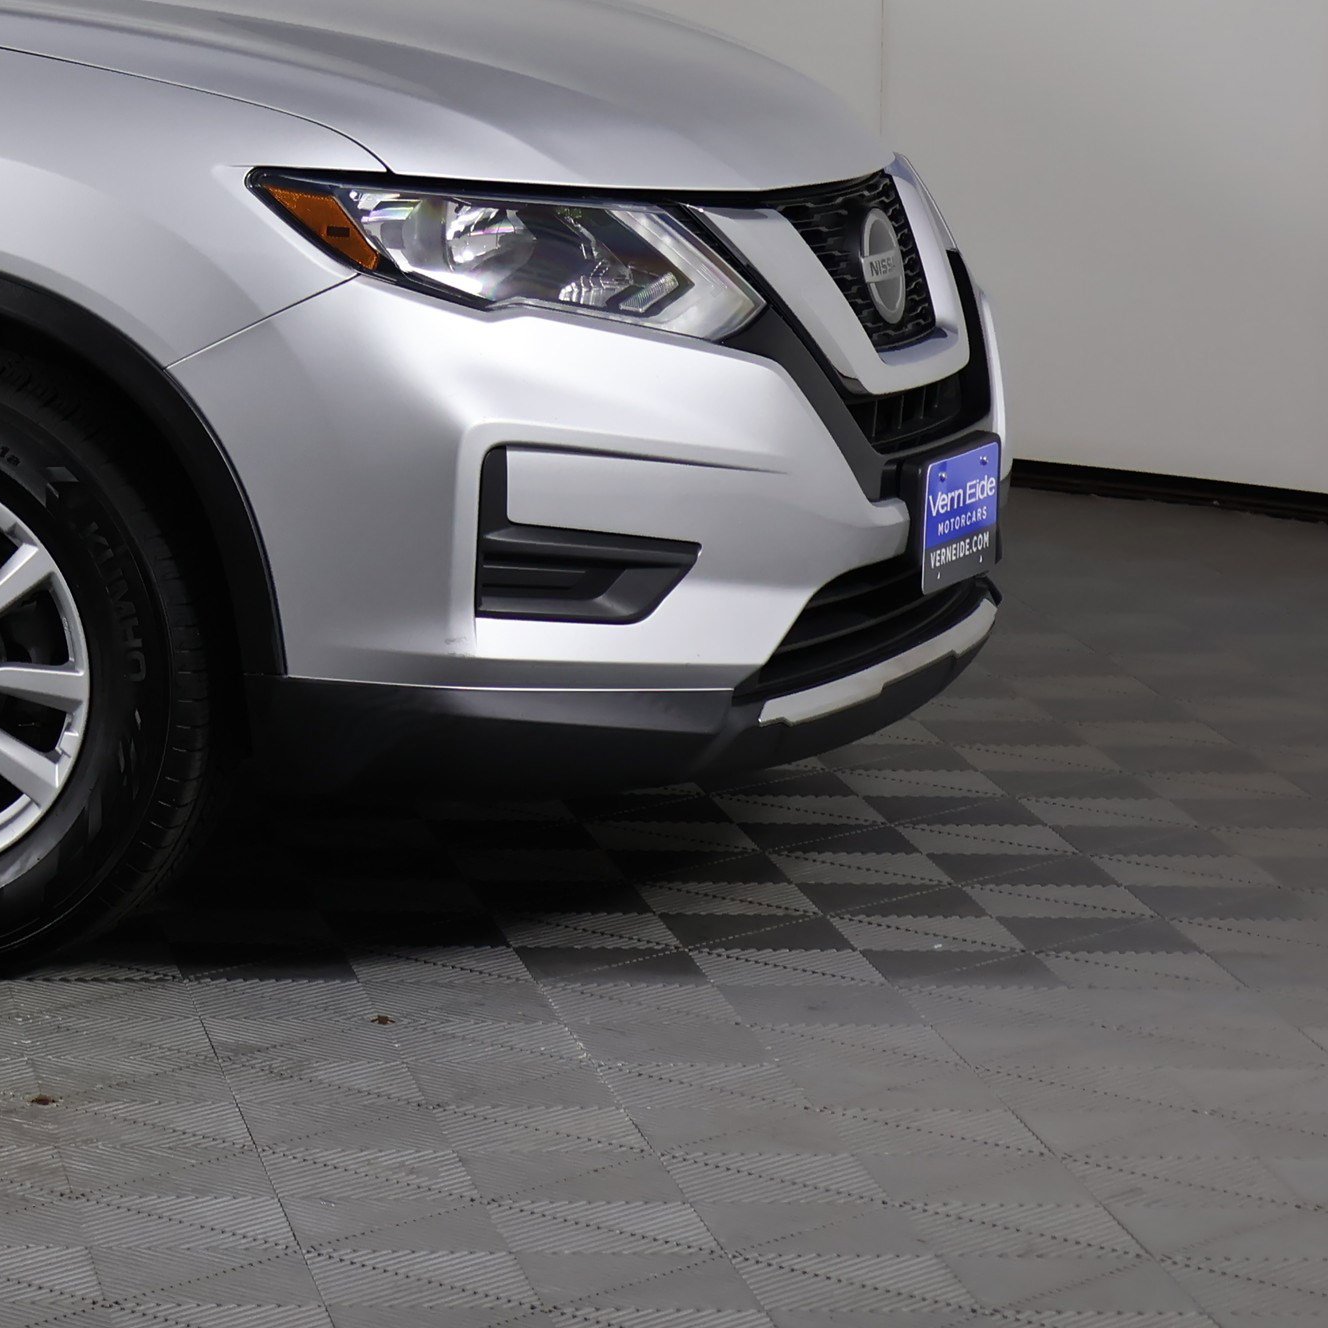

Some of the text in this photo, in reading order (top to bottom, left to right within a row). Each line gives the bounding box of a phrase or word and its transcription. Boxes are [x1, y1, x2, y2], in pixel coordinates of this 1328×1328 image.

[928, 475, 996, 517] Vern Eide
[937, 505, 987, 536] MOTORCARS
[930, 530, 990, 569] VERNEIDE.COM
